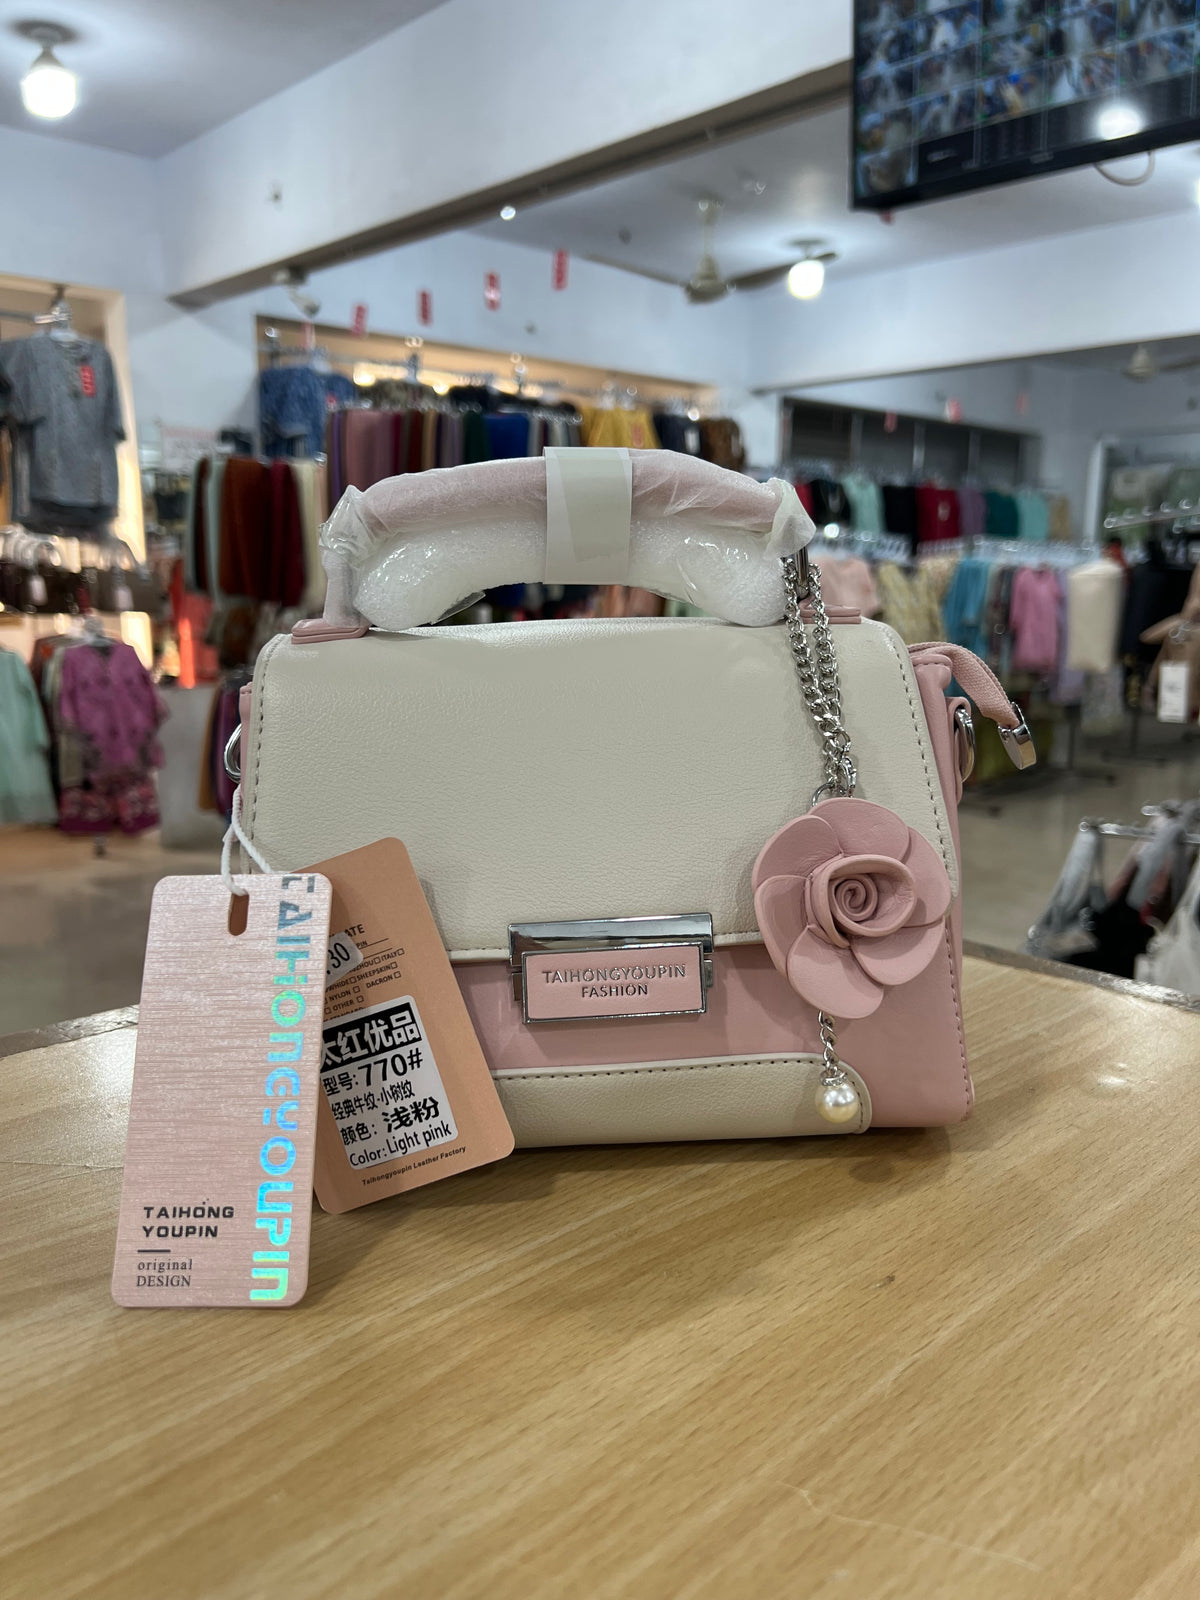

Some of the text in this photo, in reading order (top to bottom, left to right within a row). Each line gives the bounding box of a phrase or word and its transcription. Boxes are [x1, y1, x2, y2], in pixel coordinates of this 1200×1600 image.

[381, 950, 398, 962] ITALY
[356, 964, 391, 981] SHEEPSKIN
[542, 963, 686, 984] TAIHONGYOUPIN
[328, 975, 393, 1001] NYLON DACRON
[581, 983, 648, 998] FASHION
[333, 999, 355, 1011] OTHER
[349, 1120, 452, 1167] Color: Light pink
[362, 1146, 467, 1186] Taihongyoupin Leather Factory
[143, 1206, 235, 1219] TAIHONG
[142, 1225, 218, 1238] YOUPIN
[137, 1258, 193, 1273] original
[136, 1274, 191, 1287] DESIGN
